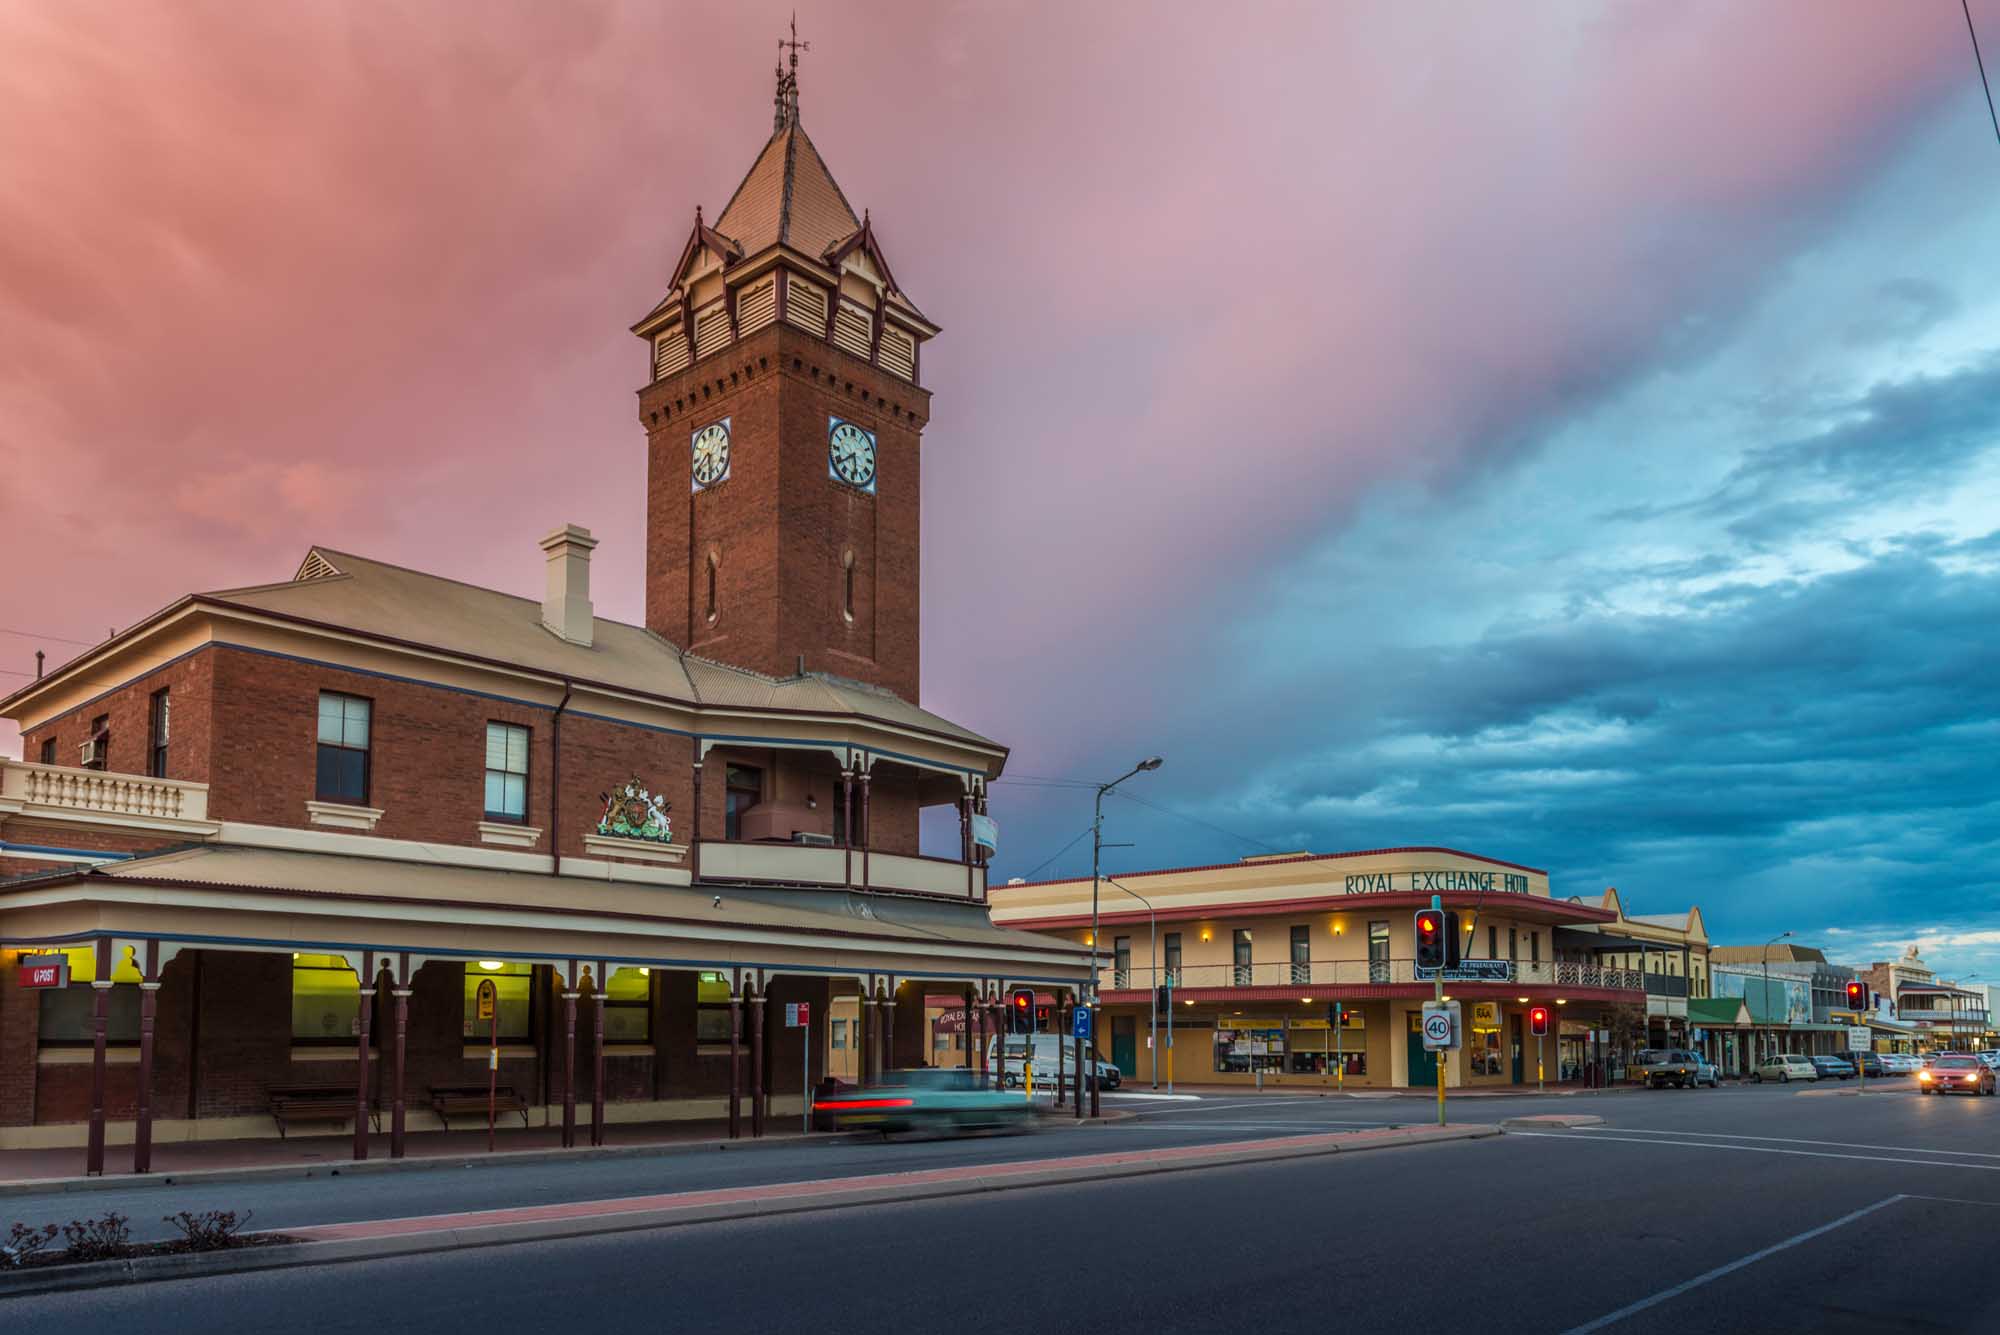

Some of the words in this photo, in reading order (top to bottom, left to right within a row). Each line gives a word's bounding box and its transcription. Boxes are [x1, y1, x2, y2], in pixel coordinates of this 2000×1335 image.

[1345, 873, 1397, 895] ROYAL
[1411, 871, 1496, 892] EXCHANGE
[40, 968, 55, 982] POST
[1077, 1010, 1088, 1025] P
[1428, 1021, 1447, 1034] 40
